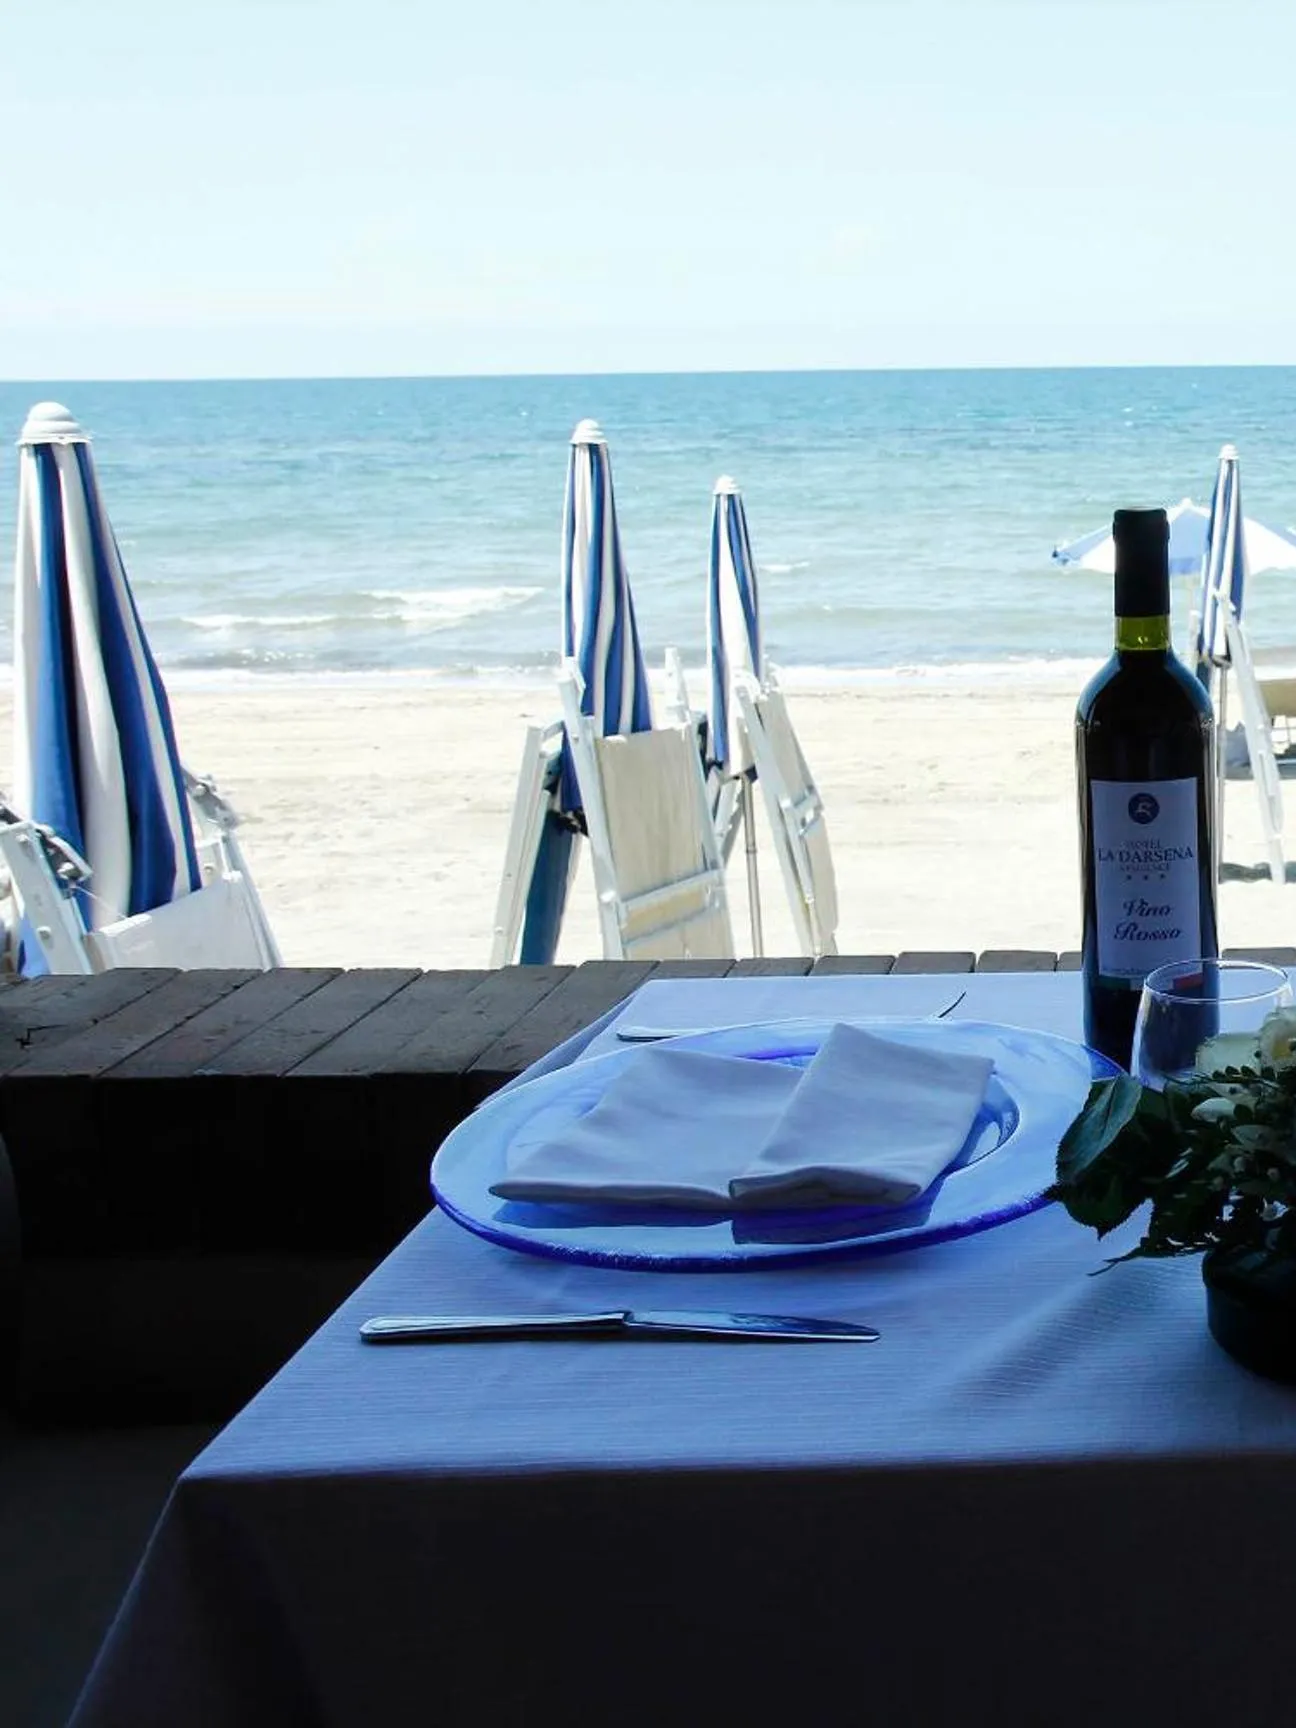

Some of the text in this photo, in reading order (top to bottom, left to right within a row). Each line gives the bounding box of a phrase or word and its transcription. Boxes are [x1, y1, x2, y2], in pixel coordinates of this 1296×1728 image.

[1098, 846, 1194, 863] LA DARSENA
[1123, 898, 1172, 917] Vino
[1114, 922, 1182, 941] Rosso
